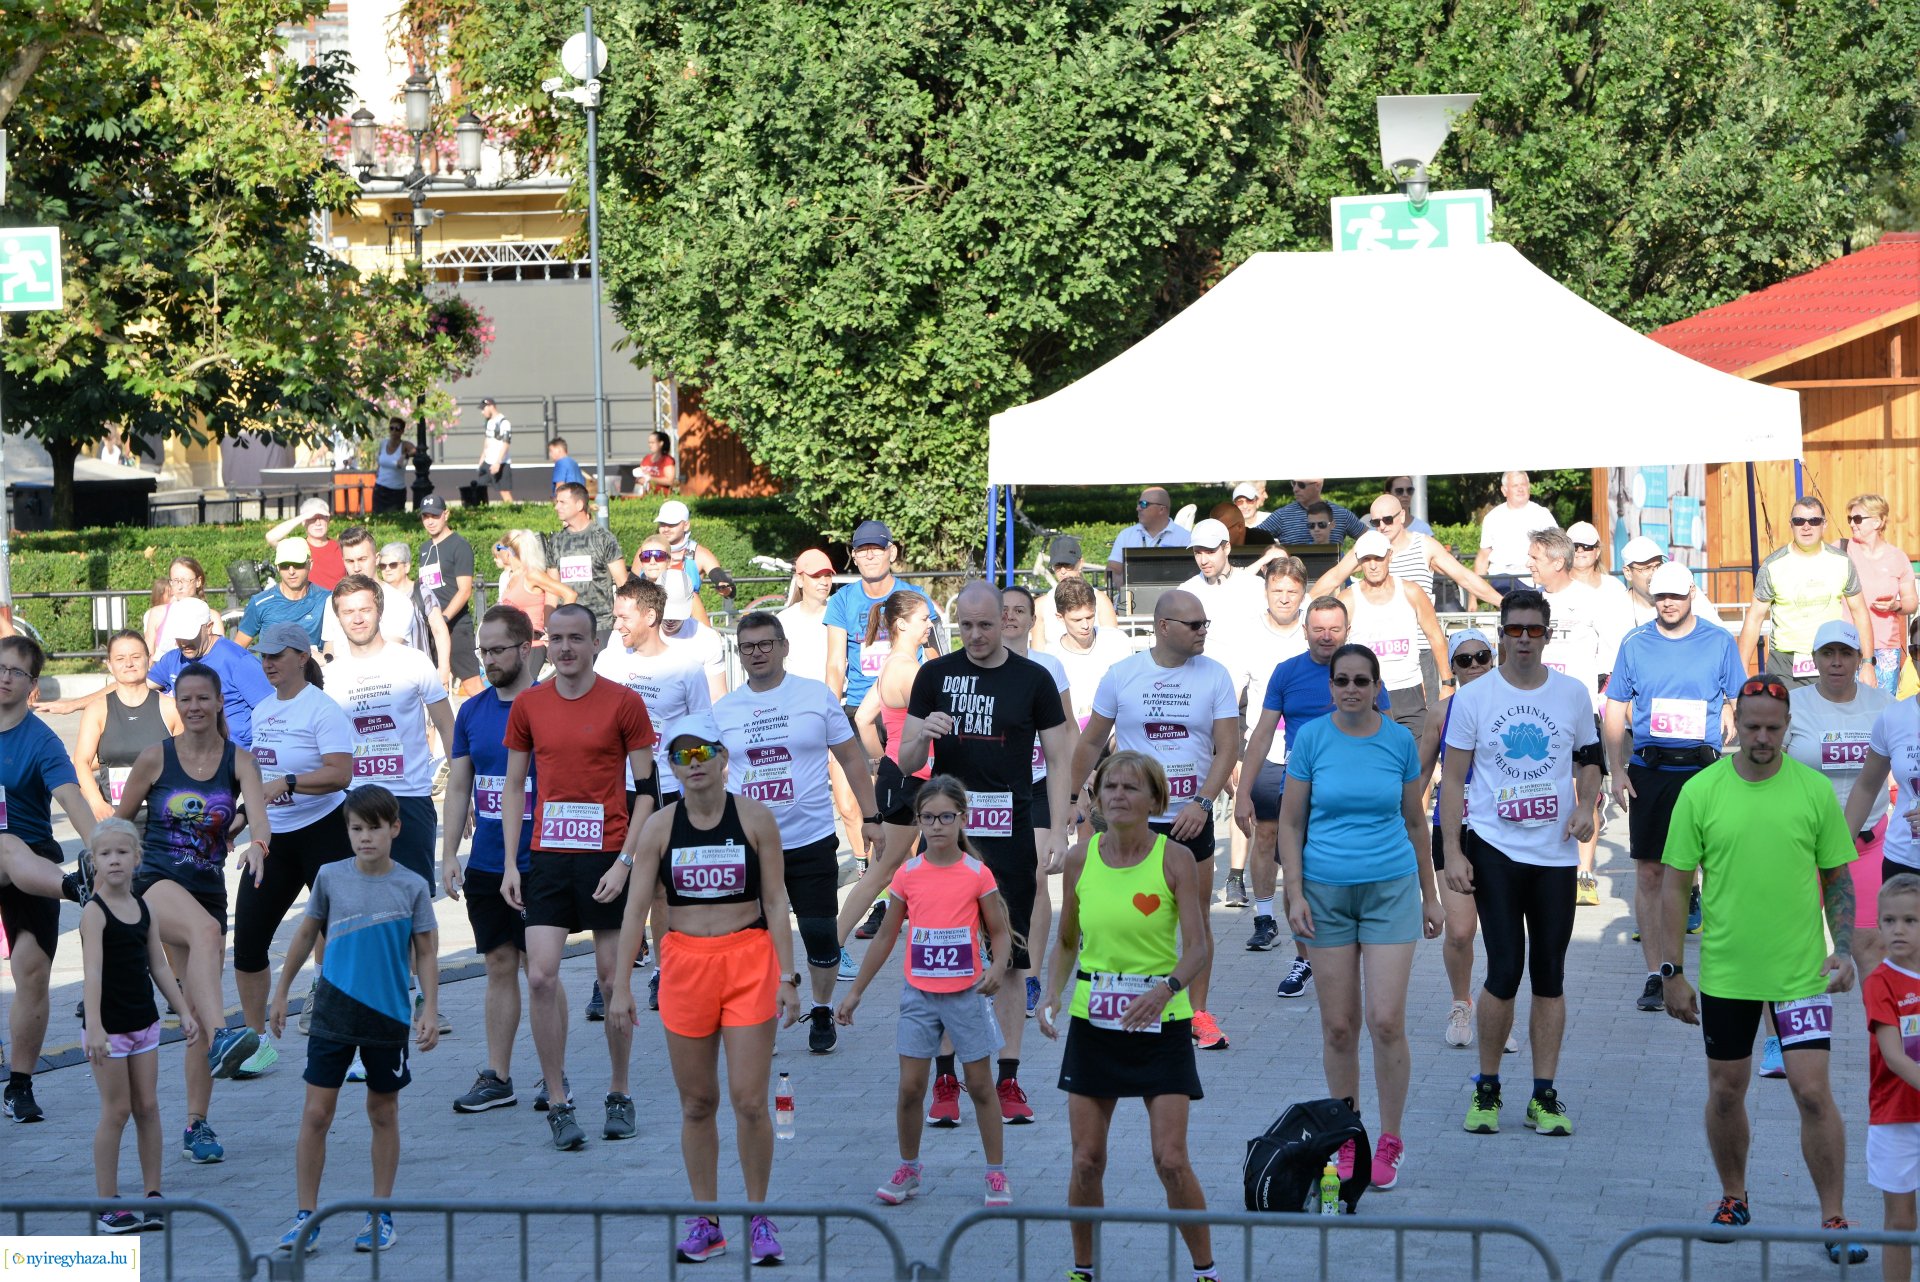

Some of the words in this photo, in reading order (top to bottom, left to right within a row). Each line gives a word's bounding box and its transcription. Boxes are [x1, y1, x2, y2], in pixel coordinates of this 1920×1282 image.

[356, 683, 392, 693] NYÍREGYHÁZI
[942, 676, 979, 694] DONT
[349, 690, 392, 701] FUTÓFESZTIVÁL
[950, 694, 995, 715] TOUCH
[359, 723, 394, 734] LEFUTOTTAM
[744, 722, 789, 734] FUTÓFESZTIVÁL
[751, 715, 790, 727] NYÍREGYHÁZI
[965, 714, 993, 735] BAR
[1491, 715, 1507, 734] SRI
[1507, 705, 1560, 738] CHINMOY
[1149, 731, 1187, 739] LEFUTOTTAM
[752, 754, 789, 766] LEFUTOTTAM
[761, 749, 769, 757] ÉN
[358, 757, 397, 774] 5195
[1523, 756, 1557, 780] ISKOLA
[743, 781, 792, 800] 10174
[1500, 798, 1558, 818] 21155
[543, 820, 601, 838] 21088
[682, 867, 736, 888] 5005
[923, 947, 959, 967] 542
[1789, 1008, 1827, 1031] 541
